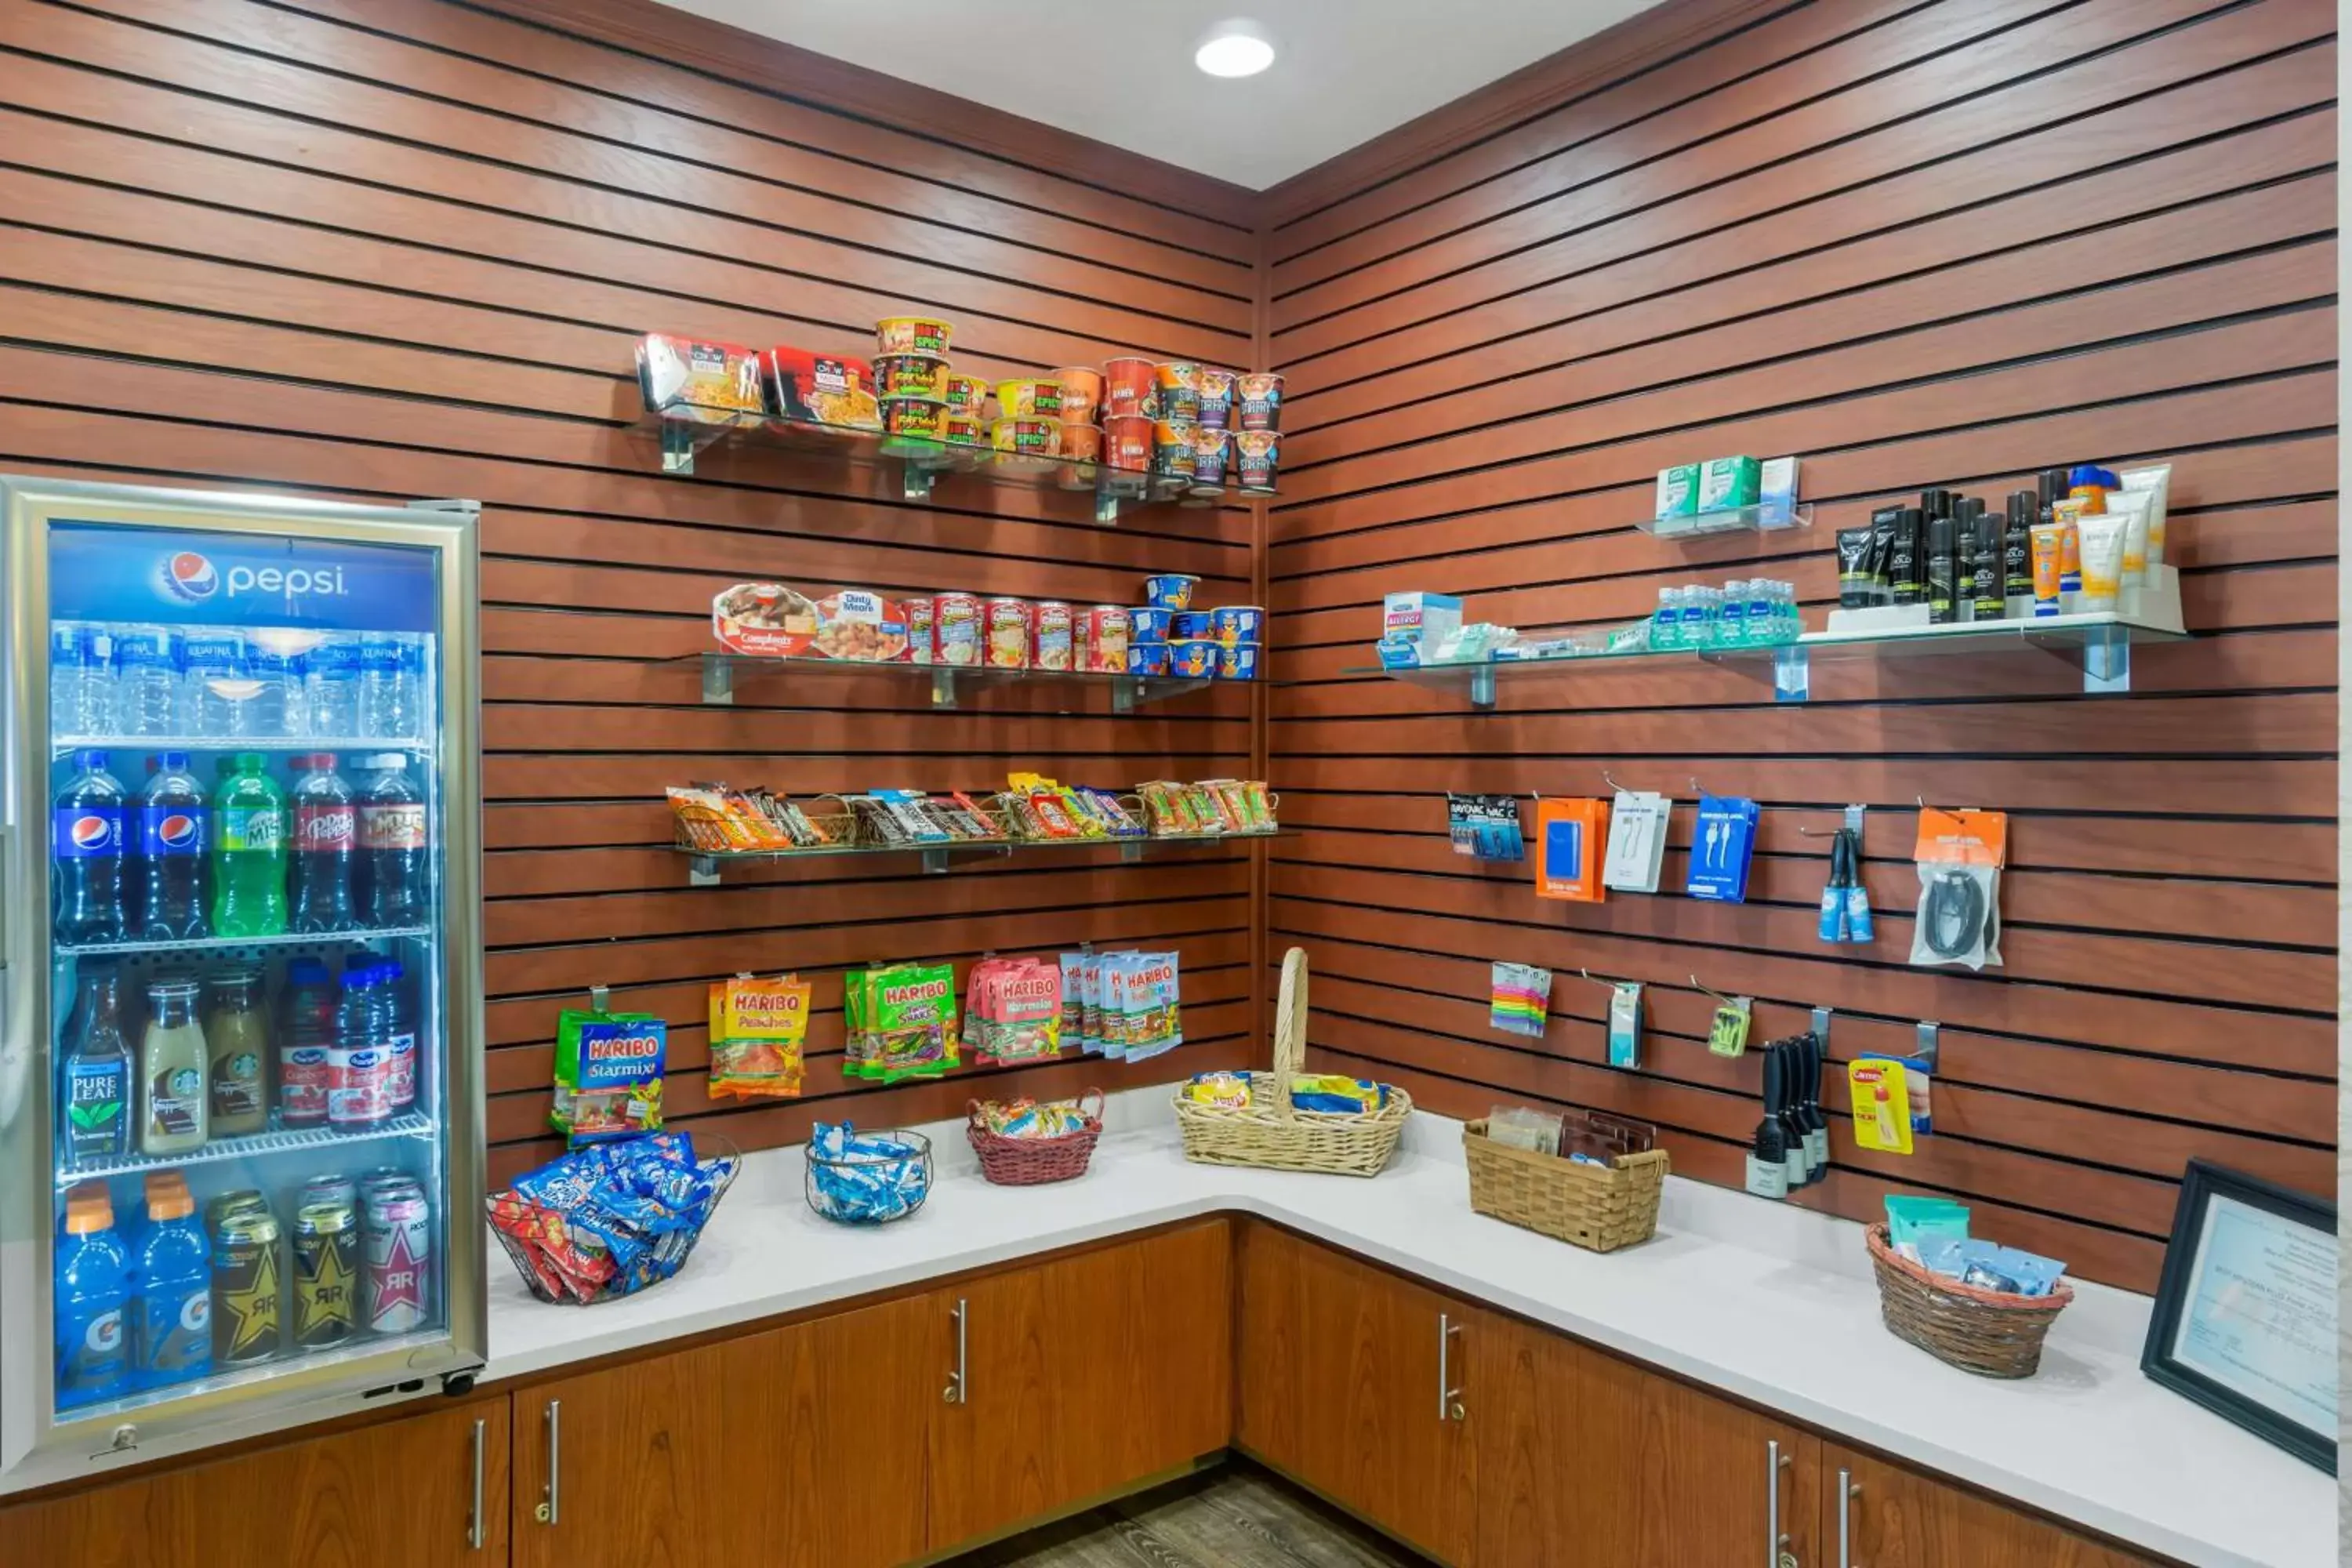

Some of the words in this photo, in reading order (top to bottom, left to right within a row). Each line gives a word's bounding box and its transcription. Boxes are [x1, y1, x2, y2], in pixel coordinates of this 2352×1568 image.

[227, 565, 343, 600] pepsi
[842, 603, 875, 613] Moore
[845, 594, 871, 606] Dinty
[1127, 965, 1173, 989] HARIBO
[884, 980, 947, 1004] HARIBO
[1002, 978, 1054, 998] HARIBO
[735, 993, 800, 1012] HARIBO
[739, 1016, 793, 1029] Peaches
[589, 1036, 659, 1060] HARIBO
[74, 1076, 117, 1089] PURE
[73, 1087, 117, 1102] LEAF
